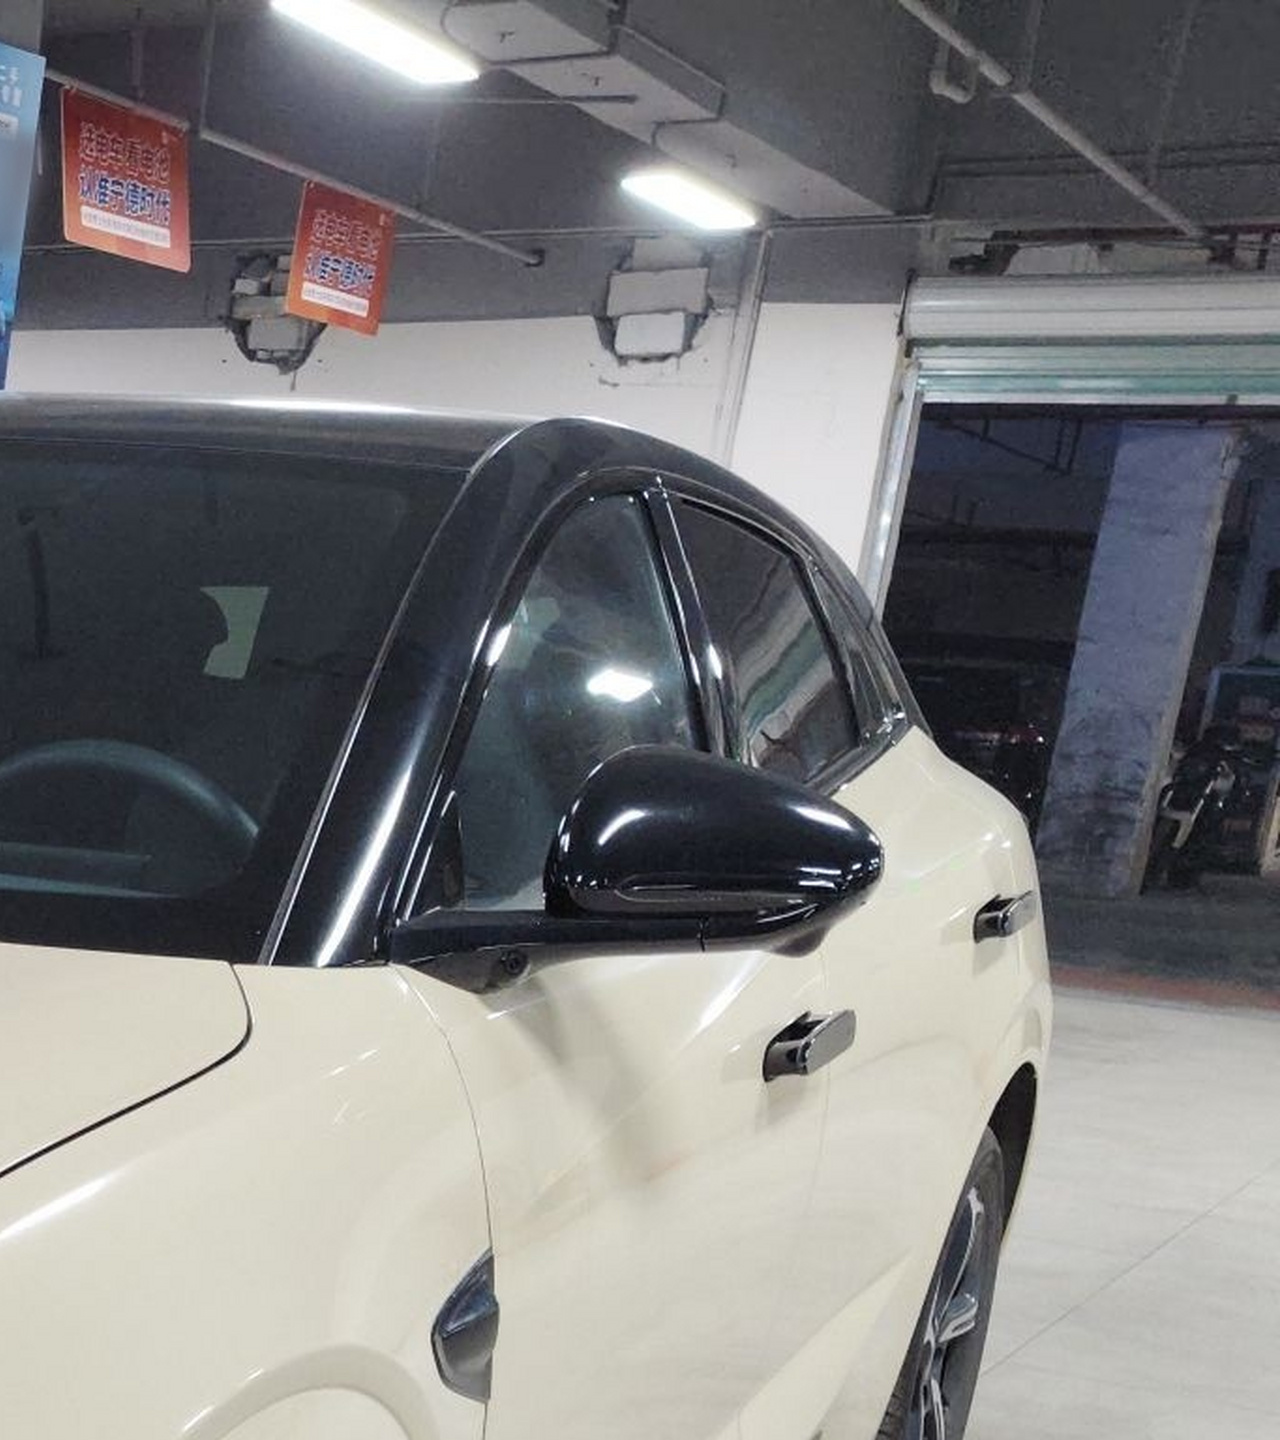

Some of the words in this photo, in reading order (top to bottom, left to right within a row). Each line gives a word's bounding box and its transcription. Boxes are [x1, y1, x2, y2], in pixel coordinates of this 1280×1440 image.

[78, 165, 171, 225] 认准宁德时代
